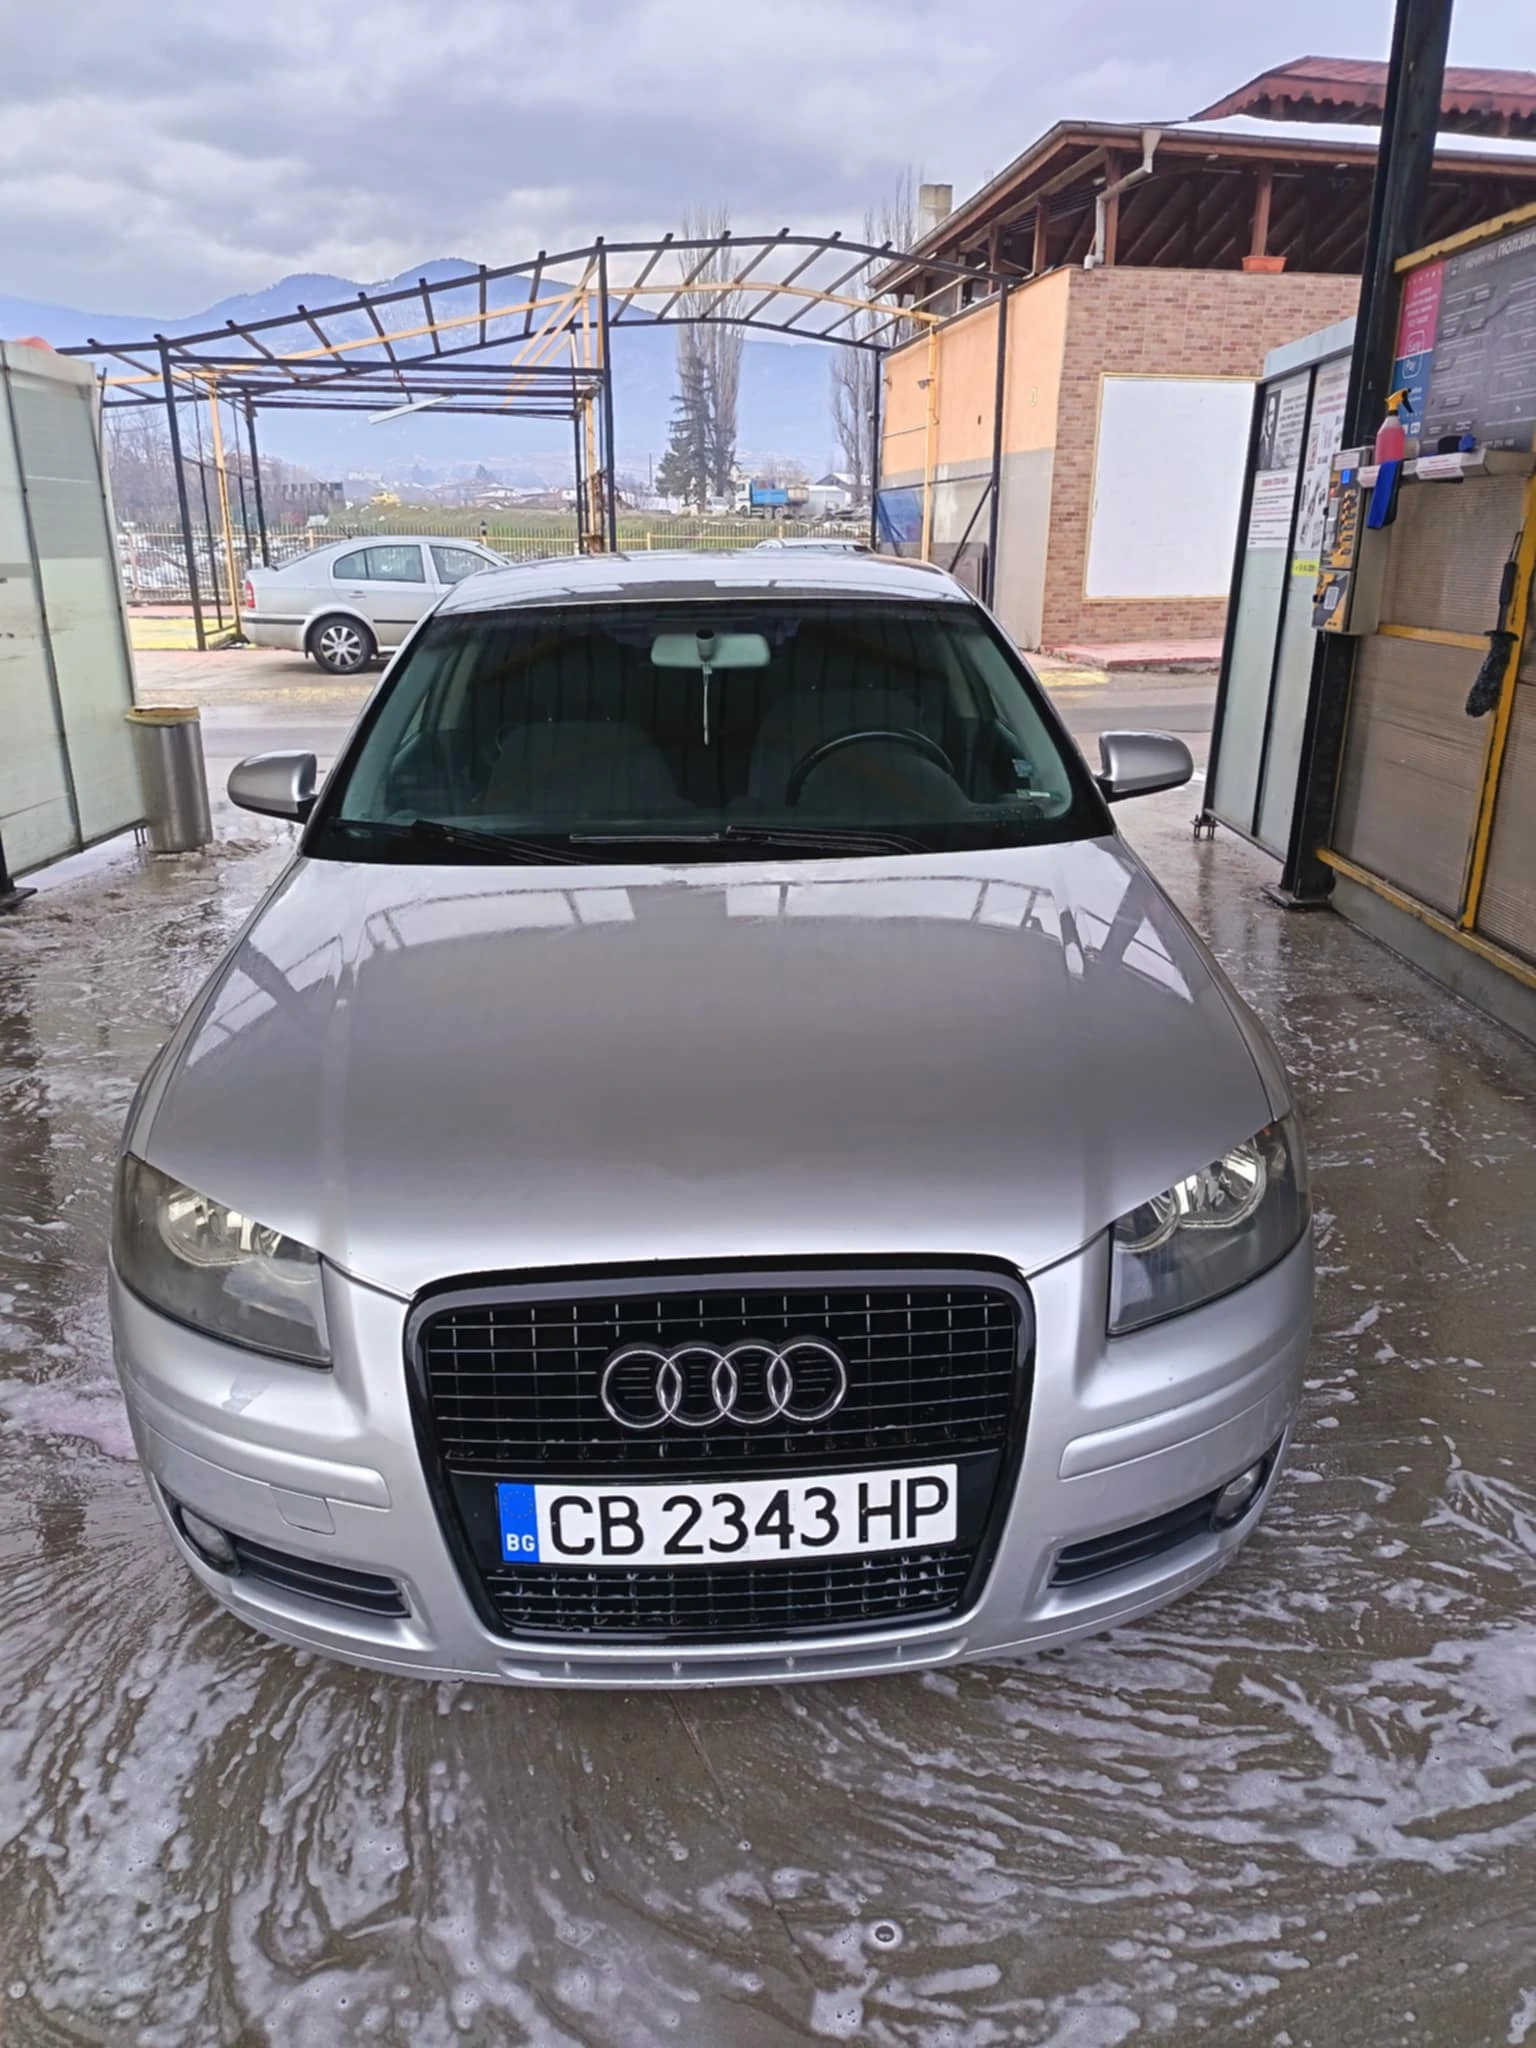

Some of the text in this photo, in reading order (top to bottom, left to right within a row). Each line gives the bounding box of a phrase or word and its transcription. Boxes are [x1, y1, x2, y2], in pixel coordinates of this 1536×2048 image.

[550, 1476, 949, 1555] CB 2343 HP
[506, 1533, 536, 1552] BG
